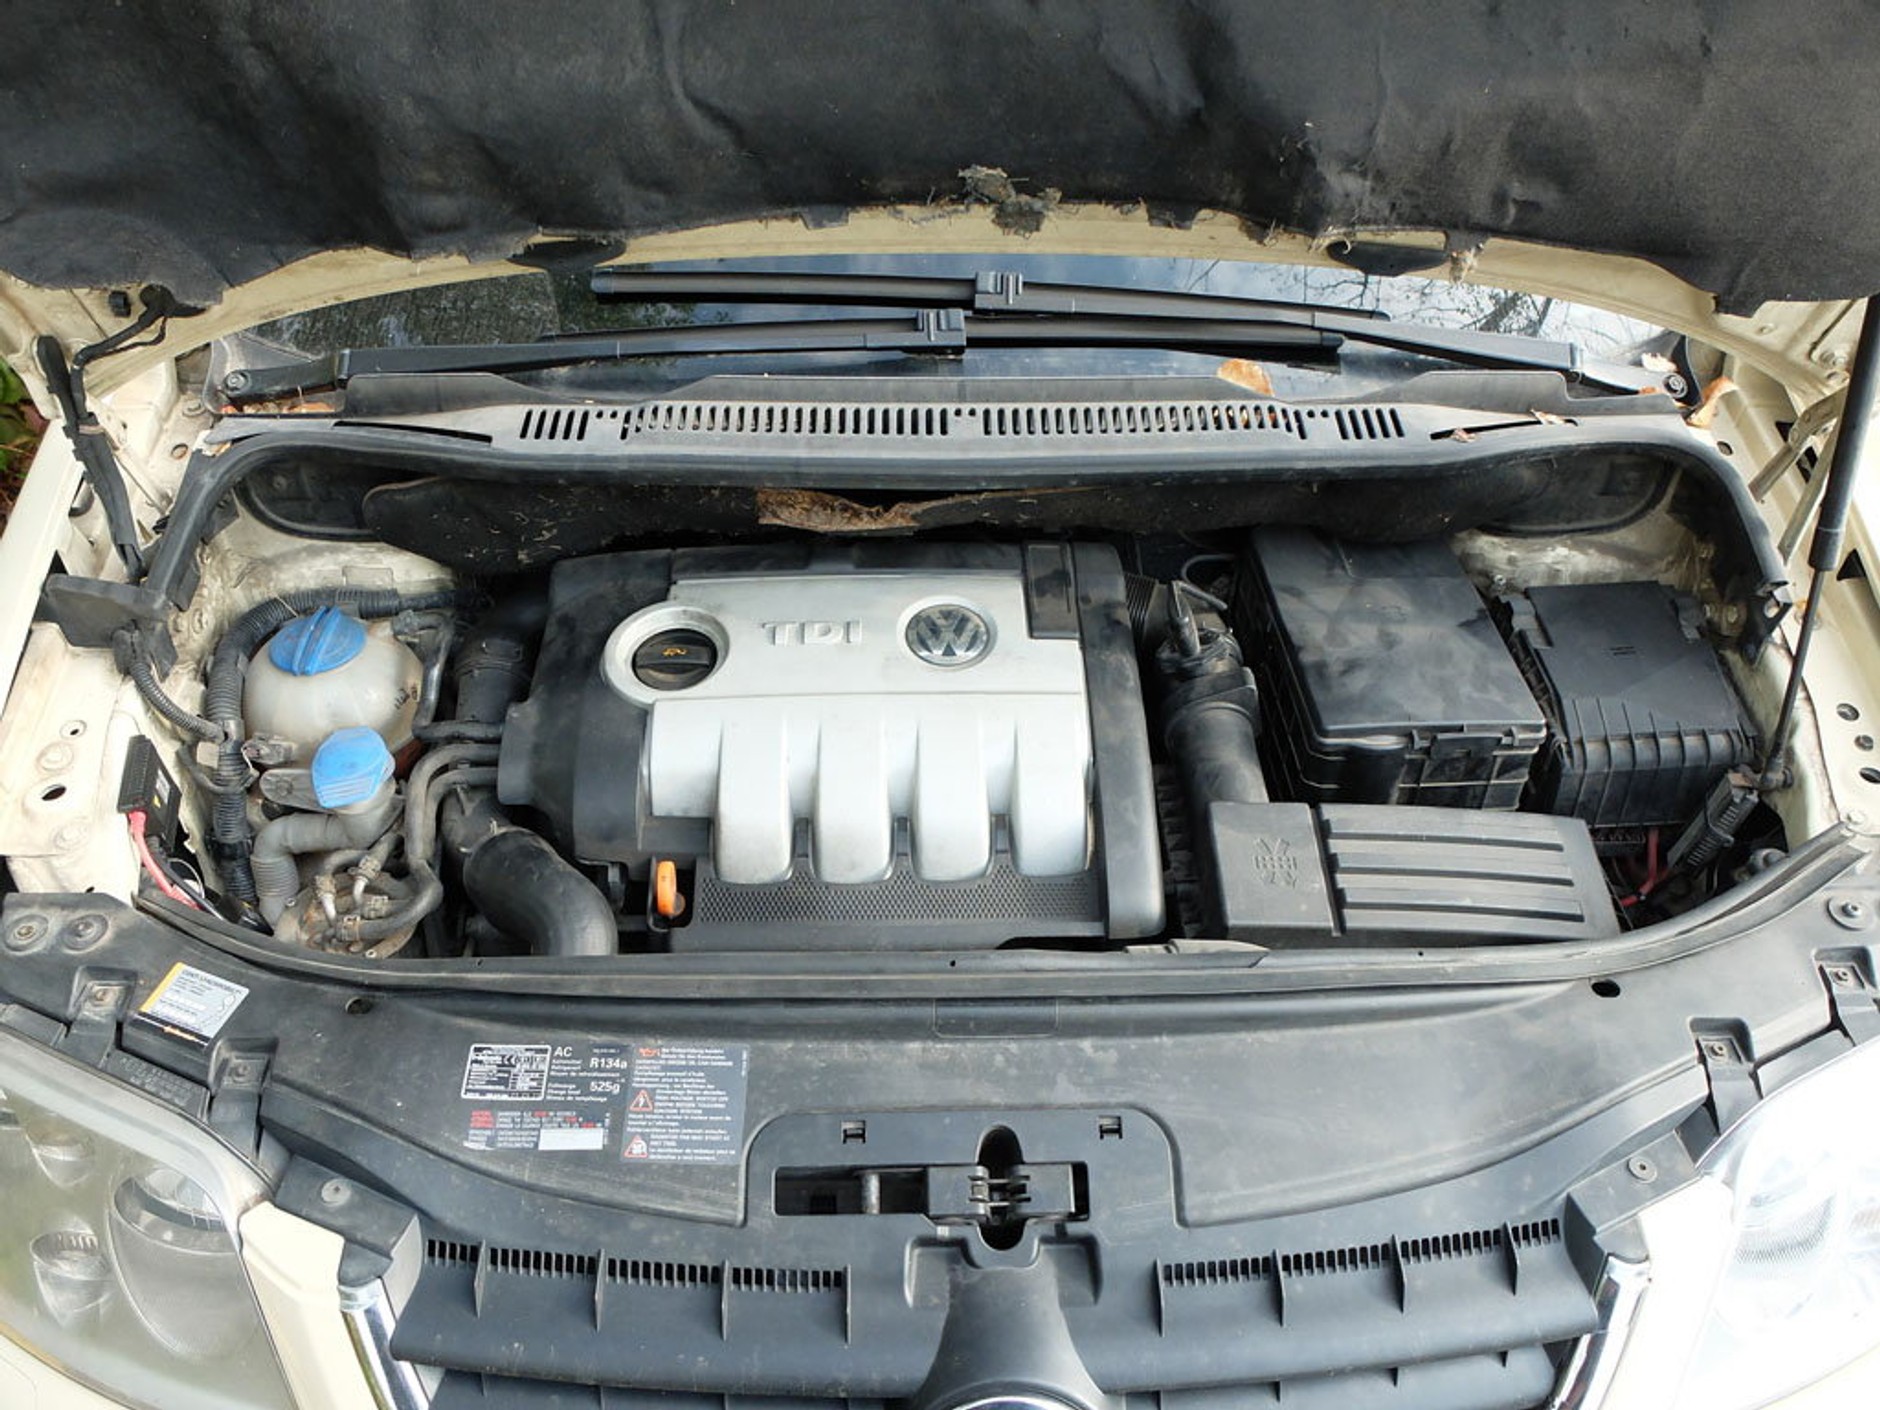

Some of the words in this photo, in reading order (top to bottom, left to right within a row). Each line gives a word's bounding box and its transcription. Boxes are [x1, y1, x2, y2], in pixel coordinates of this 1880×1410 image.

[761, 619, 862, 646] TDI
[553, 1046, 573, 1058] AC
[589, 1057, 628, 1070] R134a
[589, 1081, 620, 1095] 525g
